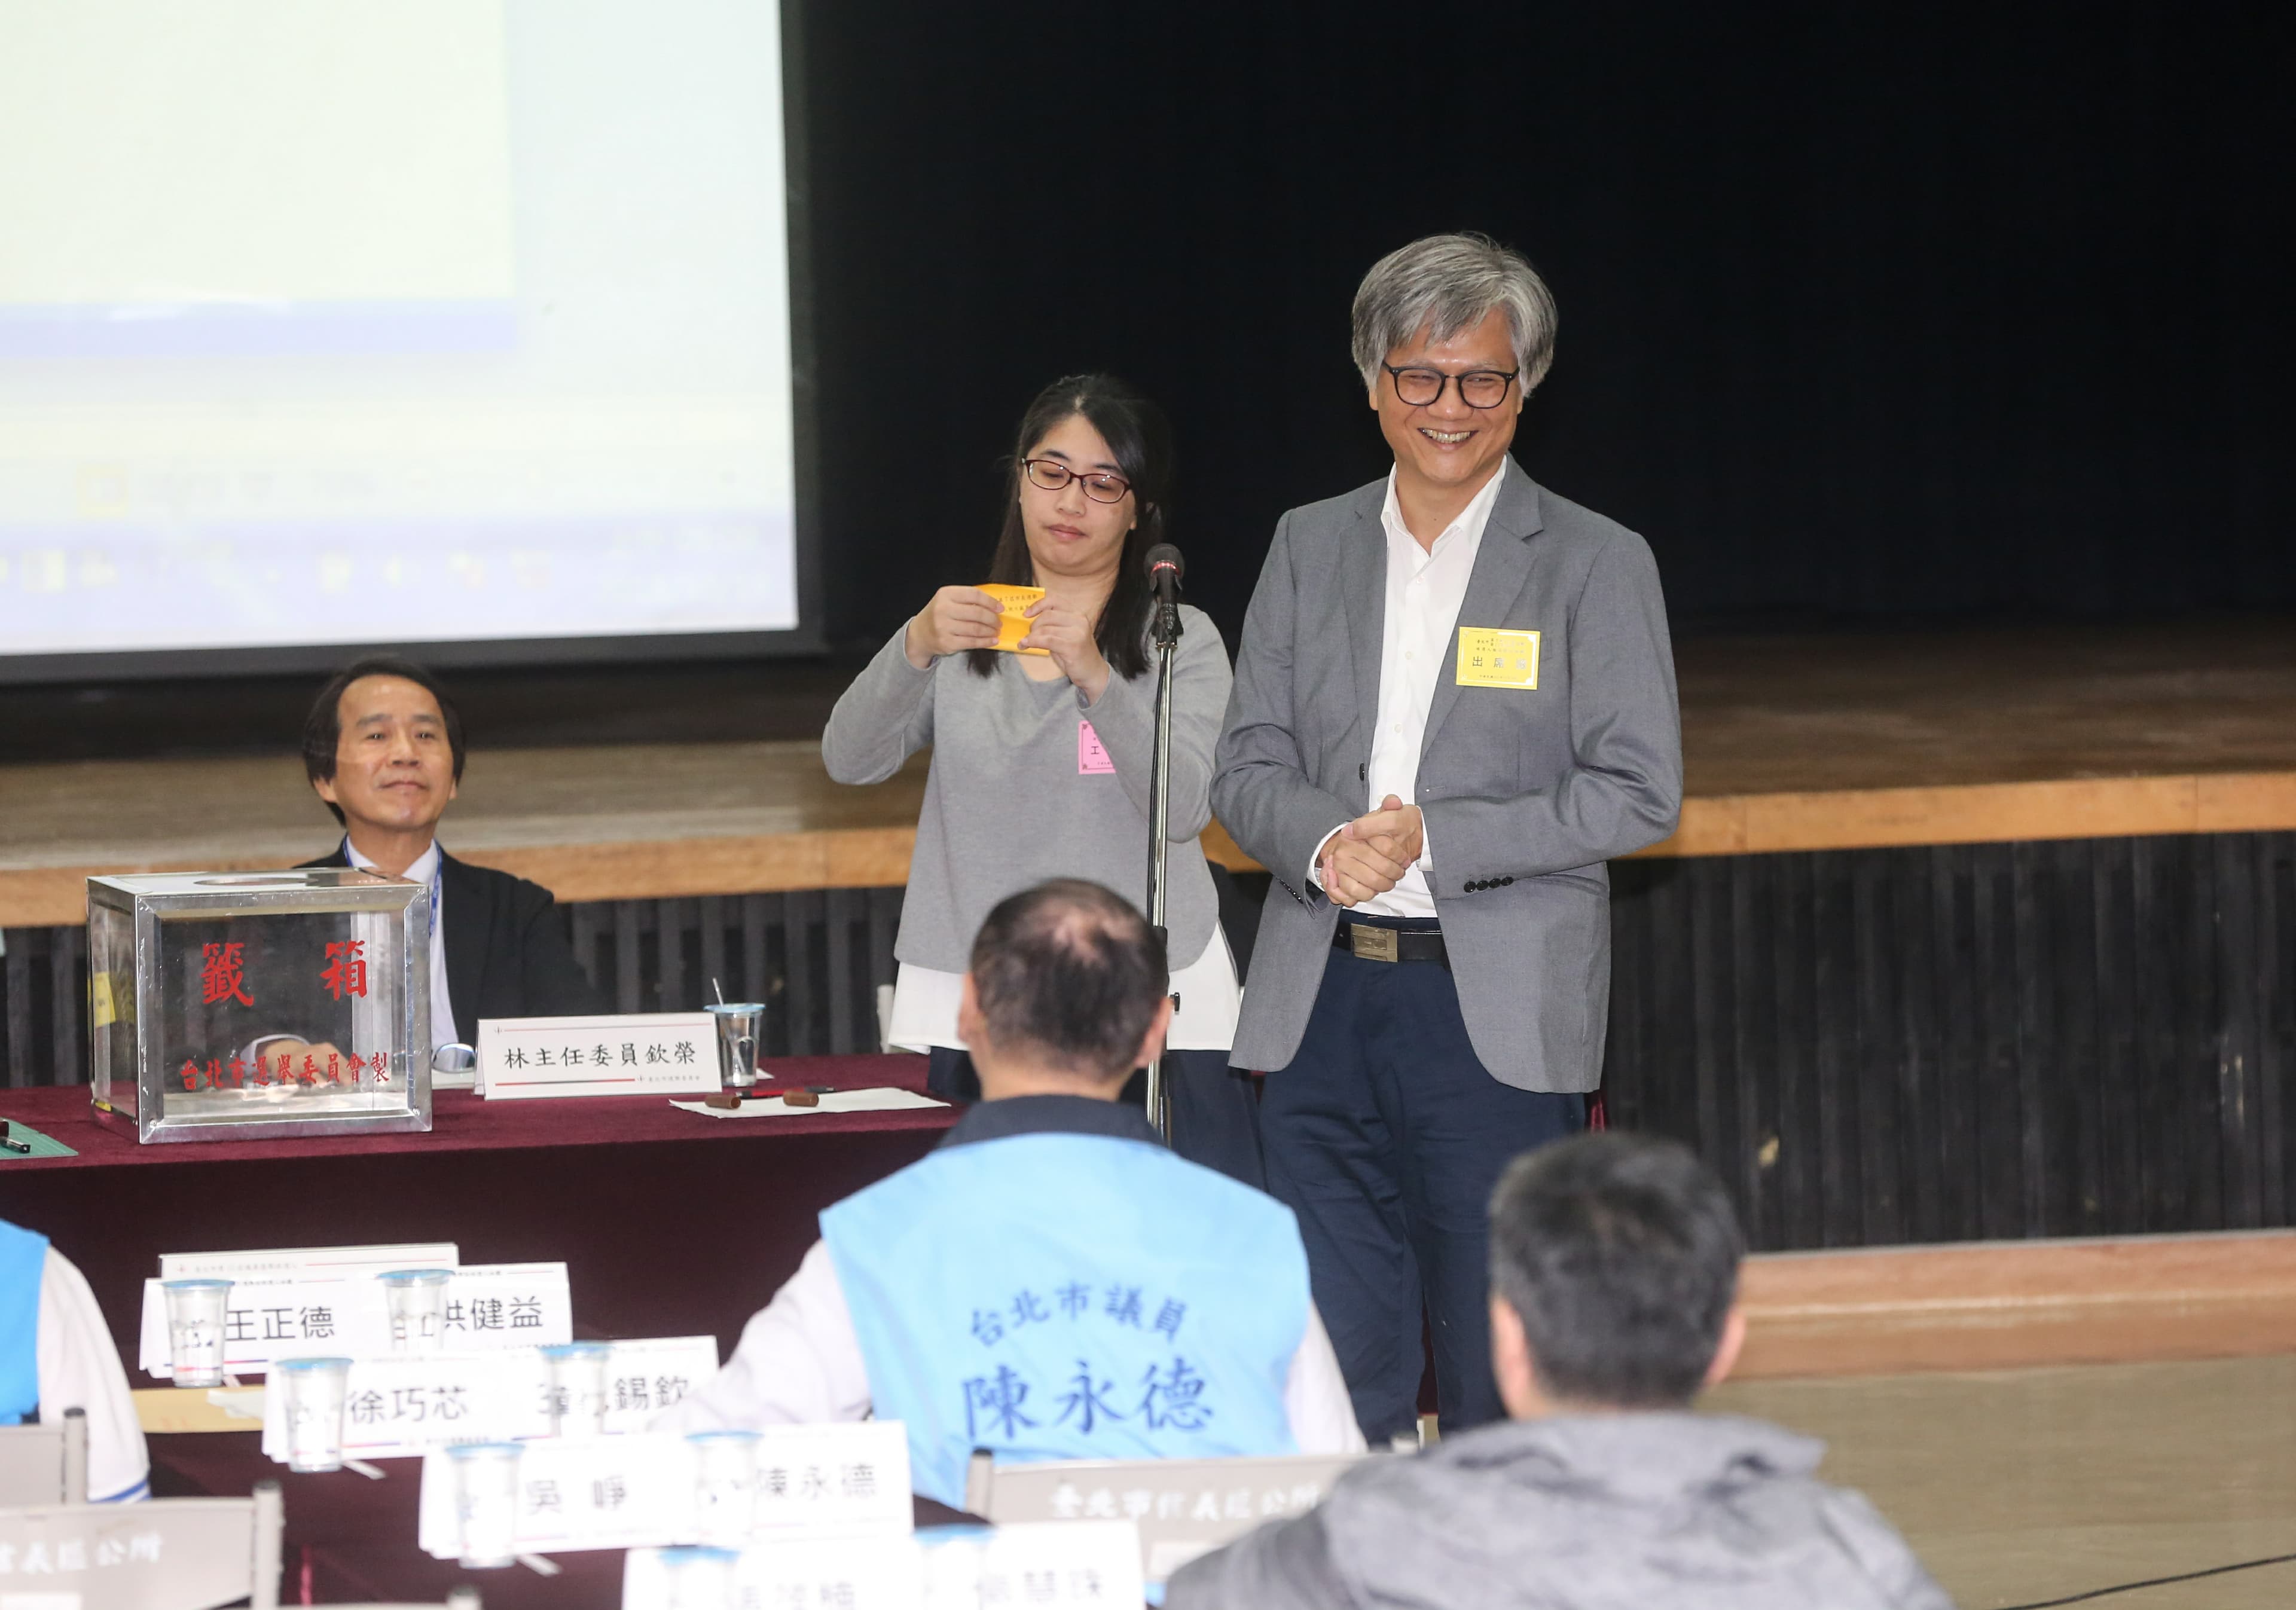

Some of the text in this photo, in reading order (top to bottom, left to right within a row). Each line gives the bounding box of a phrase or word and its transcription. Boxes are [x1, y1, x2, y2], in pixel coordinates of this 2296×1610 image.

[504, 1041, 696, 1070] 林主任委員欽榮
[224, 1305, 335, 1343] 王正德
[970, 1281, 1187, 1348] 台北市議員
[349, 1386, 470, 1425] 徐巧芯
[961, 1355, 1214, 1440] 陳永德
